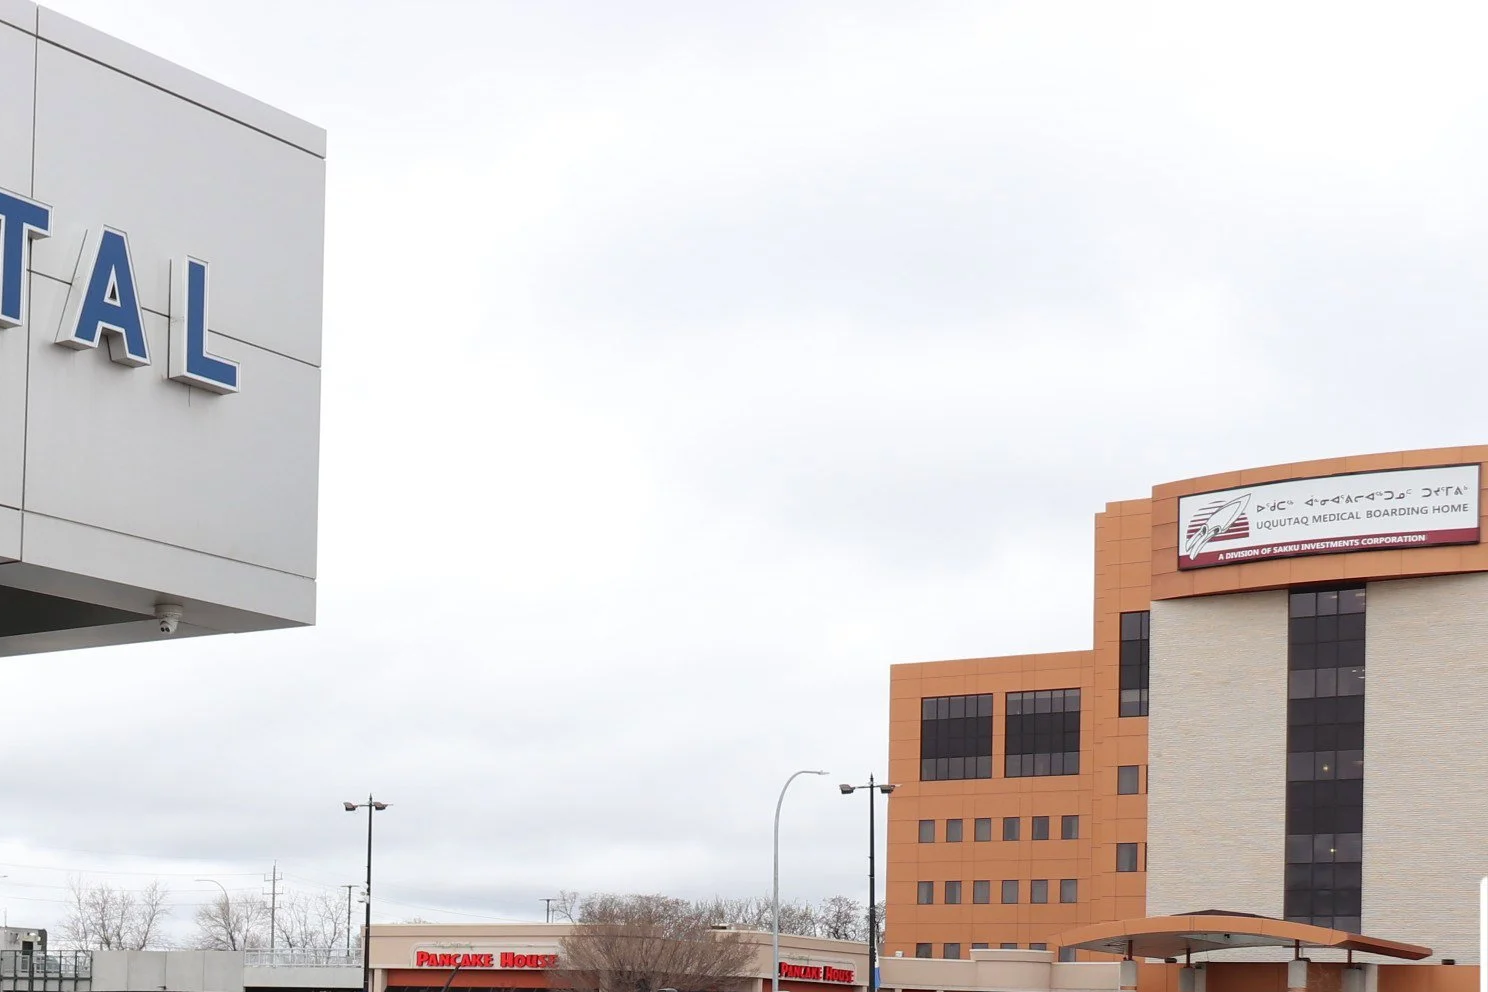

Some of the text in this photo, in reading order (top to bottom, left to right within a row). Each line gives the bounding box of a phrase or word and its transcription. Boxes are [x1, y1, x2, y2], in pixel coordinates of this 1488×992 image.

[1256, 503, 1469, 530] UQUUTAQ MEDICAL BOARDING HOME
[1225, 549, 1260, 560] DIVISION
[1272, 544, 1300, 554] SAKKU
[1300, 538, 1360, 551] INVESTMENTS
[1361, 534, 1426, 546] CORPORATION
[416, 951, 560, 968] PANCAKE HOUSE
[779, 962, 855, 983] PANCAKE HOUSE
